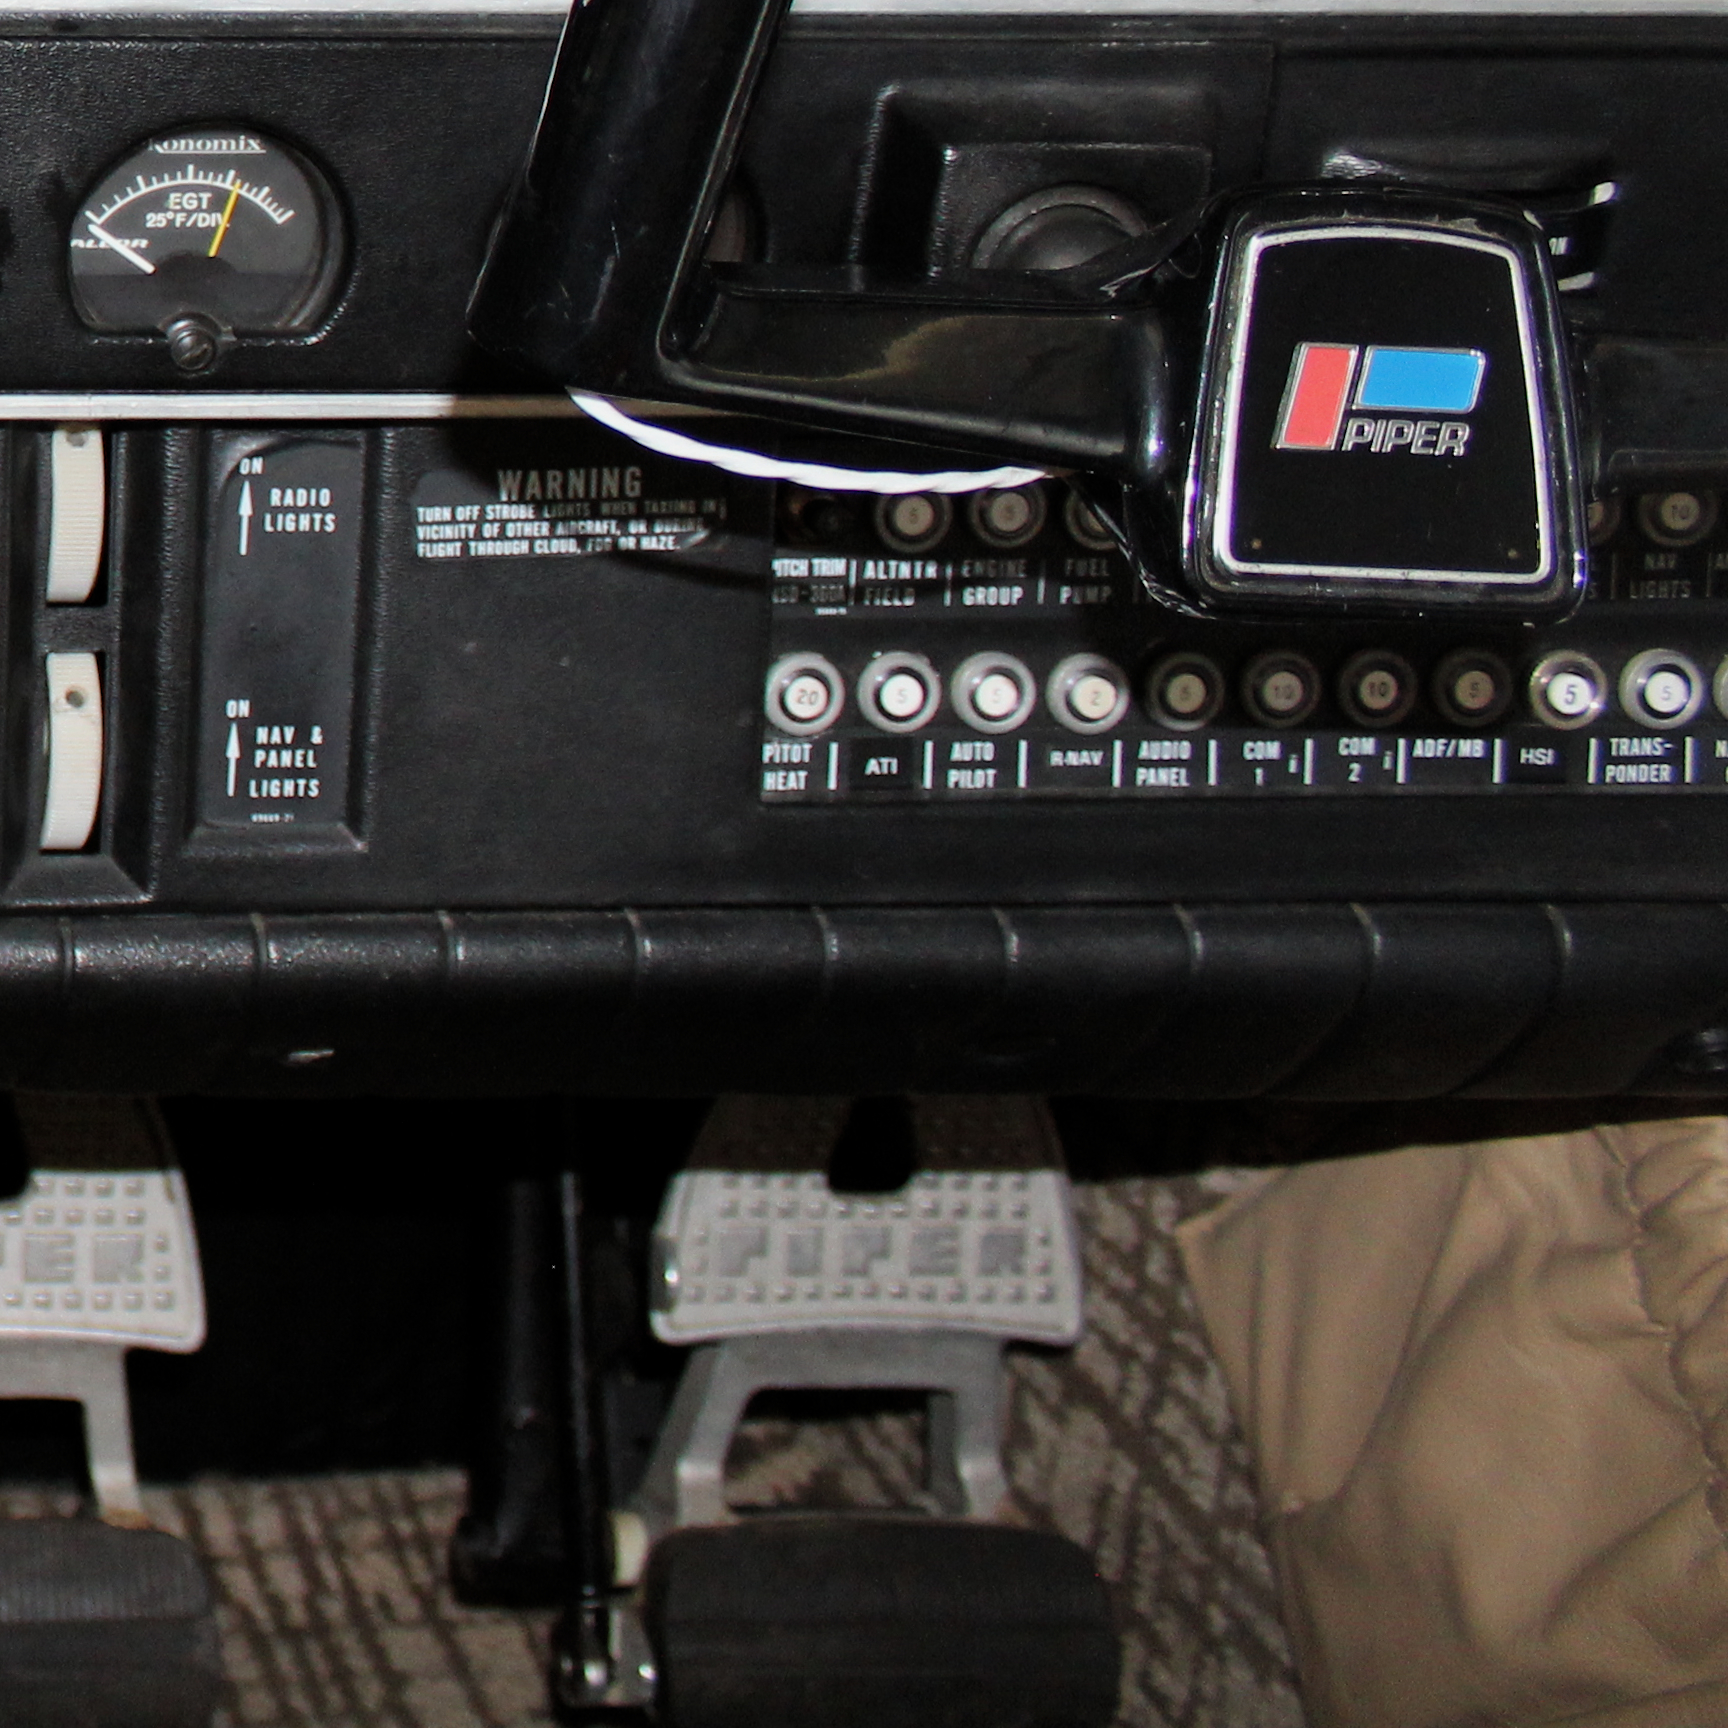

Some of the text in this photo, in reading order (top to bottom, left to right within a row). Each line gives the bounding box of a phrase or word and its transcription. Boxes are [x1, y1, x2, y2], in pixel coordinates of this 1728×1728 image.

[169, 192, 211, 209] EGT
[1343, 418, 1470, 456] PIPER
[499, 467, 642, 501] WARNING
[270, 487, 330, 507] RADIO
[264, 511, 336, 533] LIGHTS
[416, 503, 536, 522] TURN OFF STROBE
[963, 585, 1023, 606] GROUP
[762, 742, 812, 763] PITOT
[950, 741, 994, 762] AUTO
[1413, 738, 1484, 758] ADF/MB
[763, 770, 807, 791] HEAT
[947, 768, 997, 789] PILOT
[1605, 763, 1672, 783] PONDER
